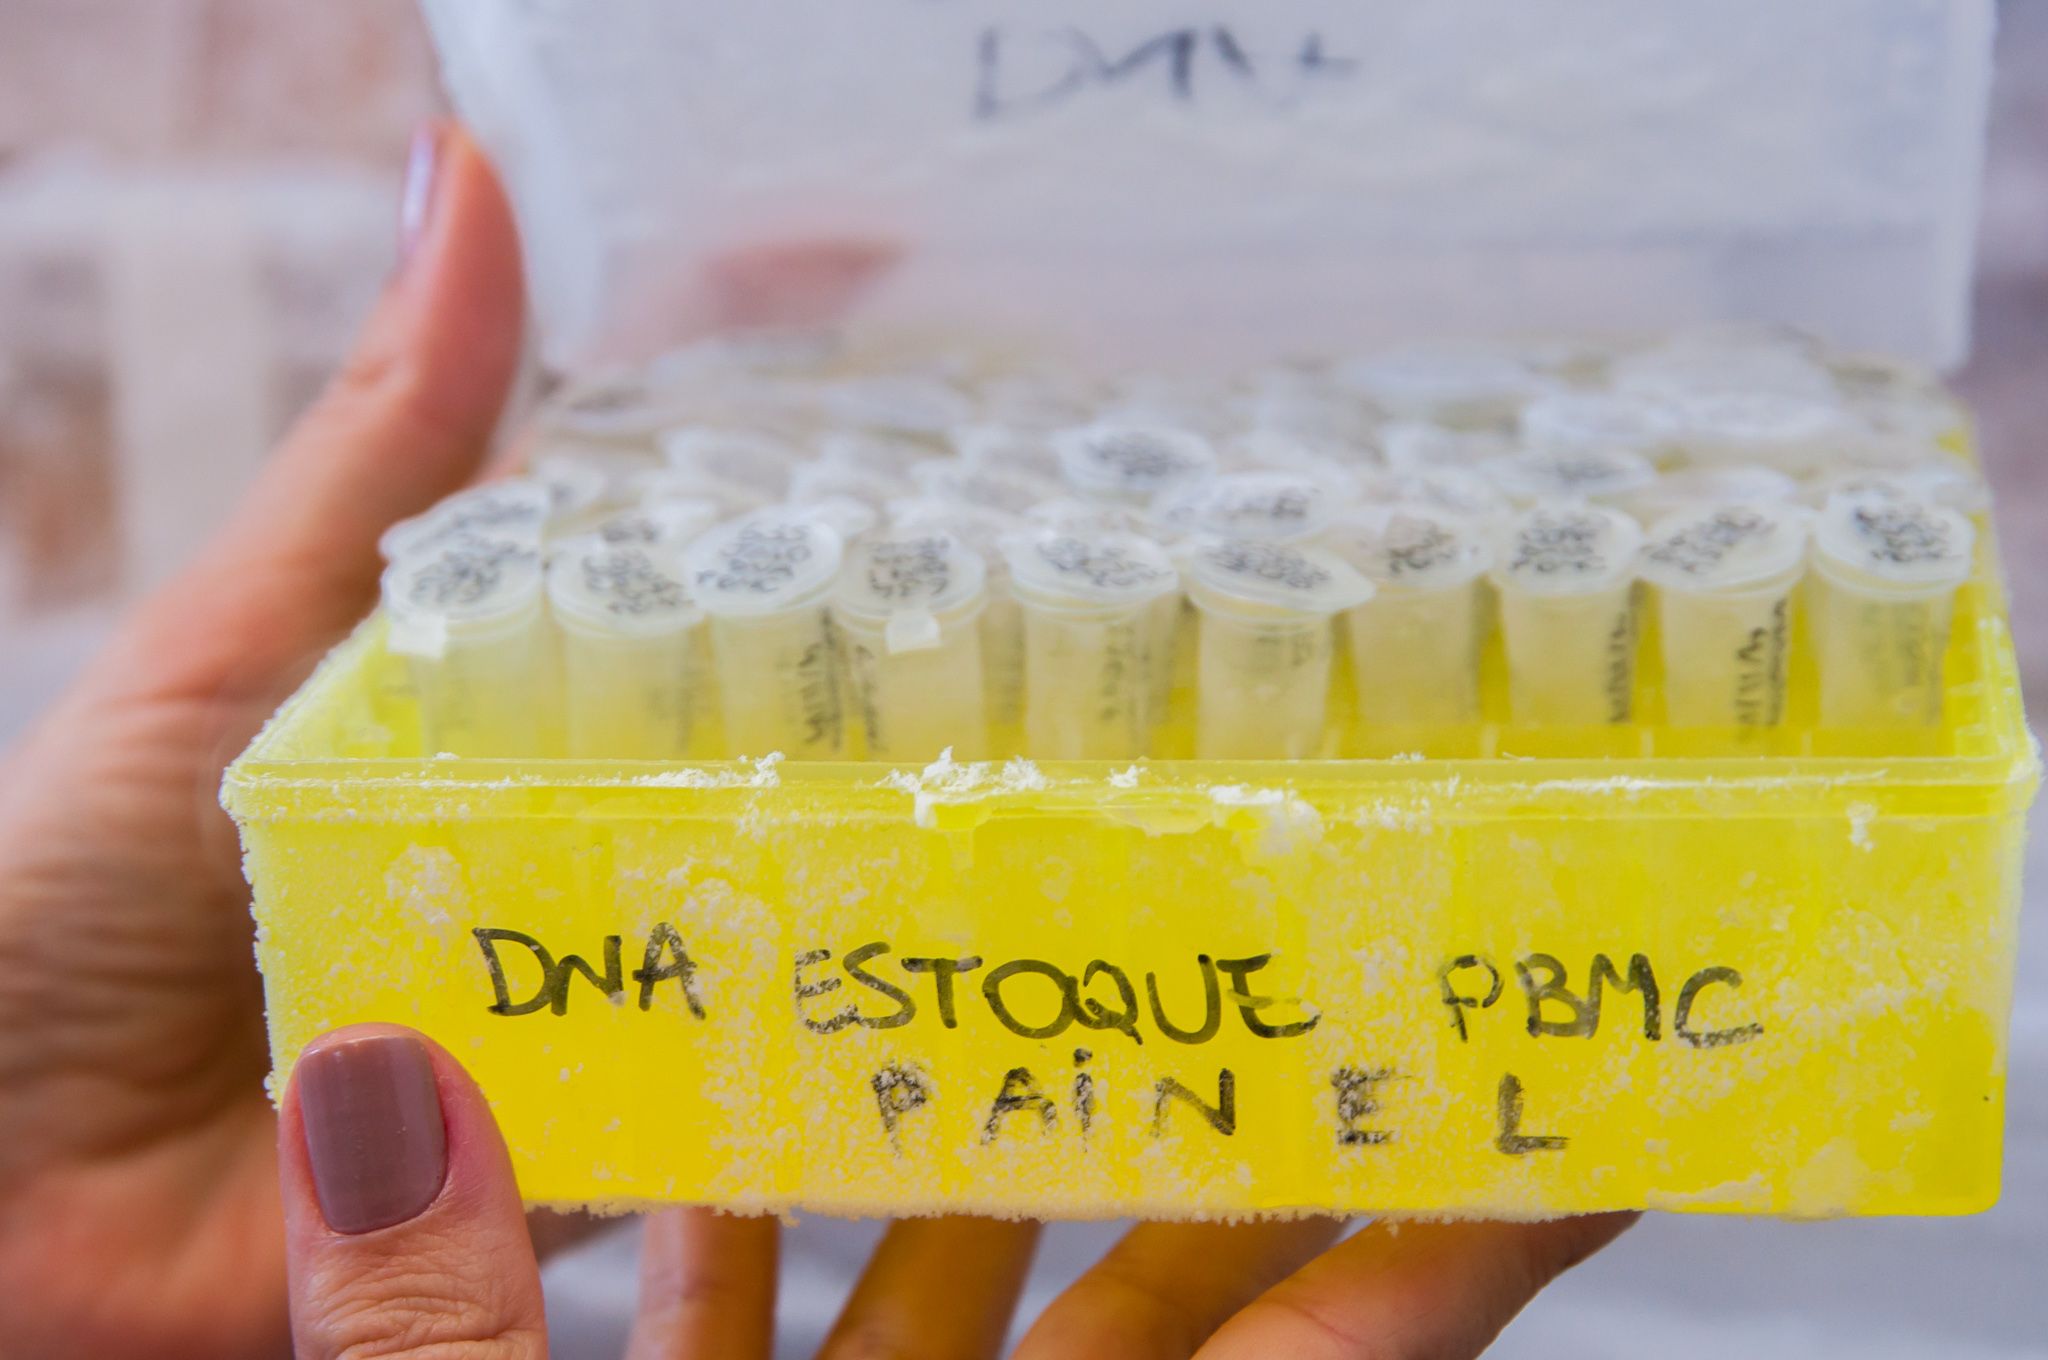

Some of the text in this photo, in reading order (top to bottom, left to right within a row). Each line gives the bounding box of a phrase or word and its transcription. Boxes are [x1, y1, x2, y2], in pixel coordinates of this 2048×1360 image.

[472, 922, 1764, 1048] DNA ESTOQUE PBMC
